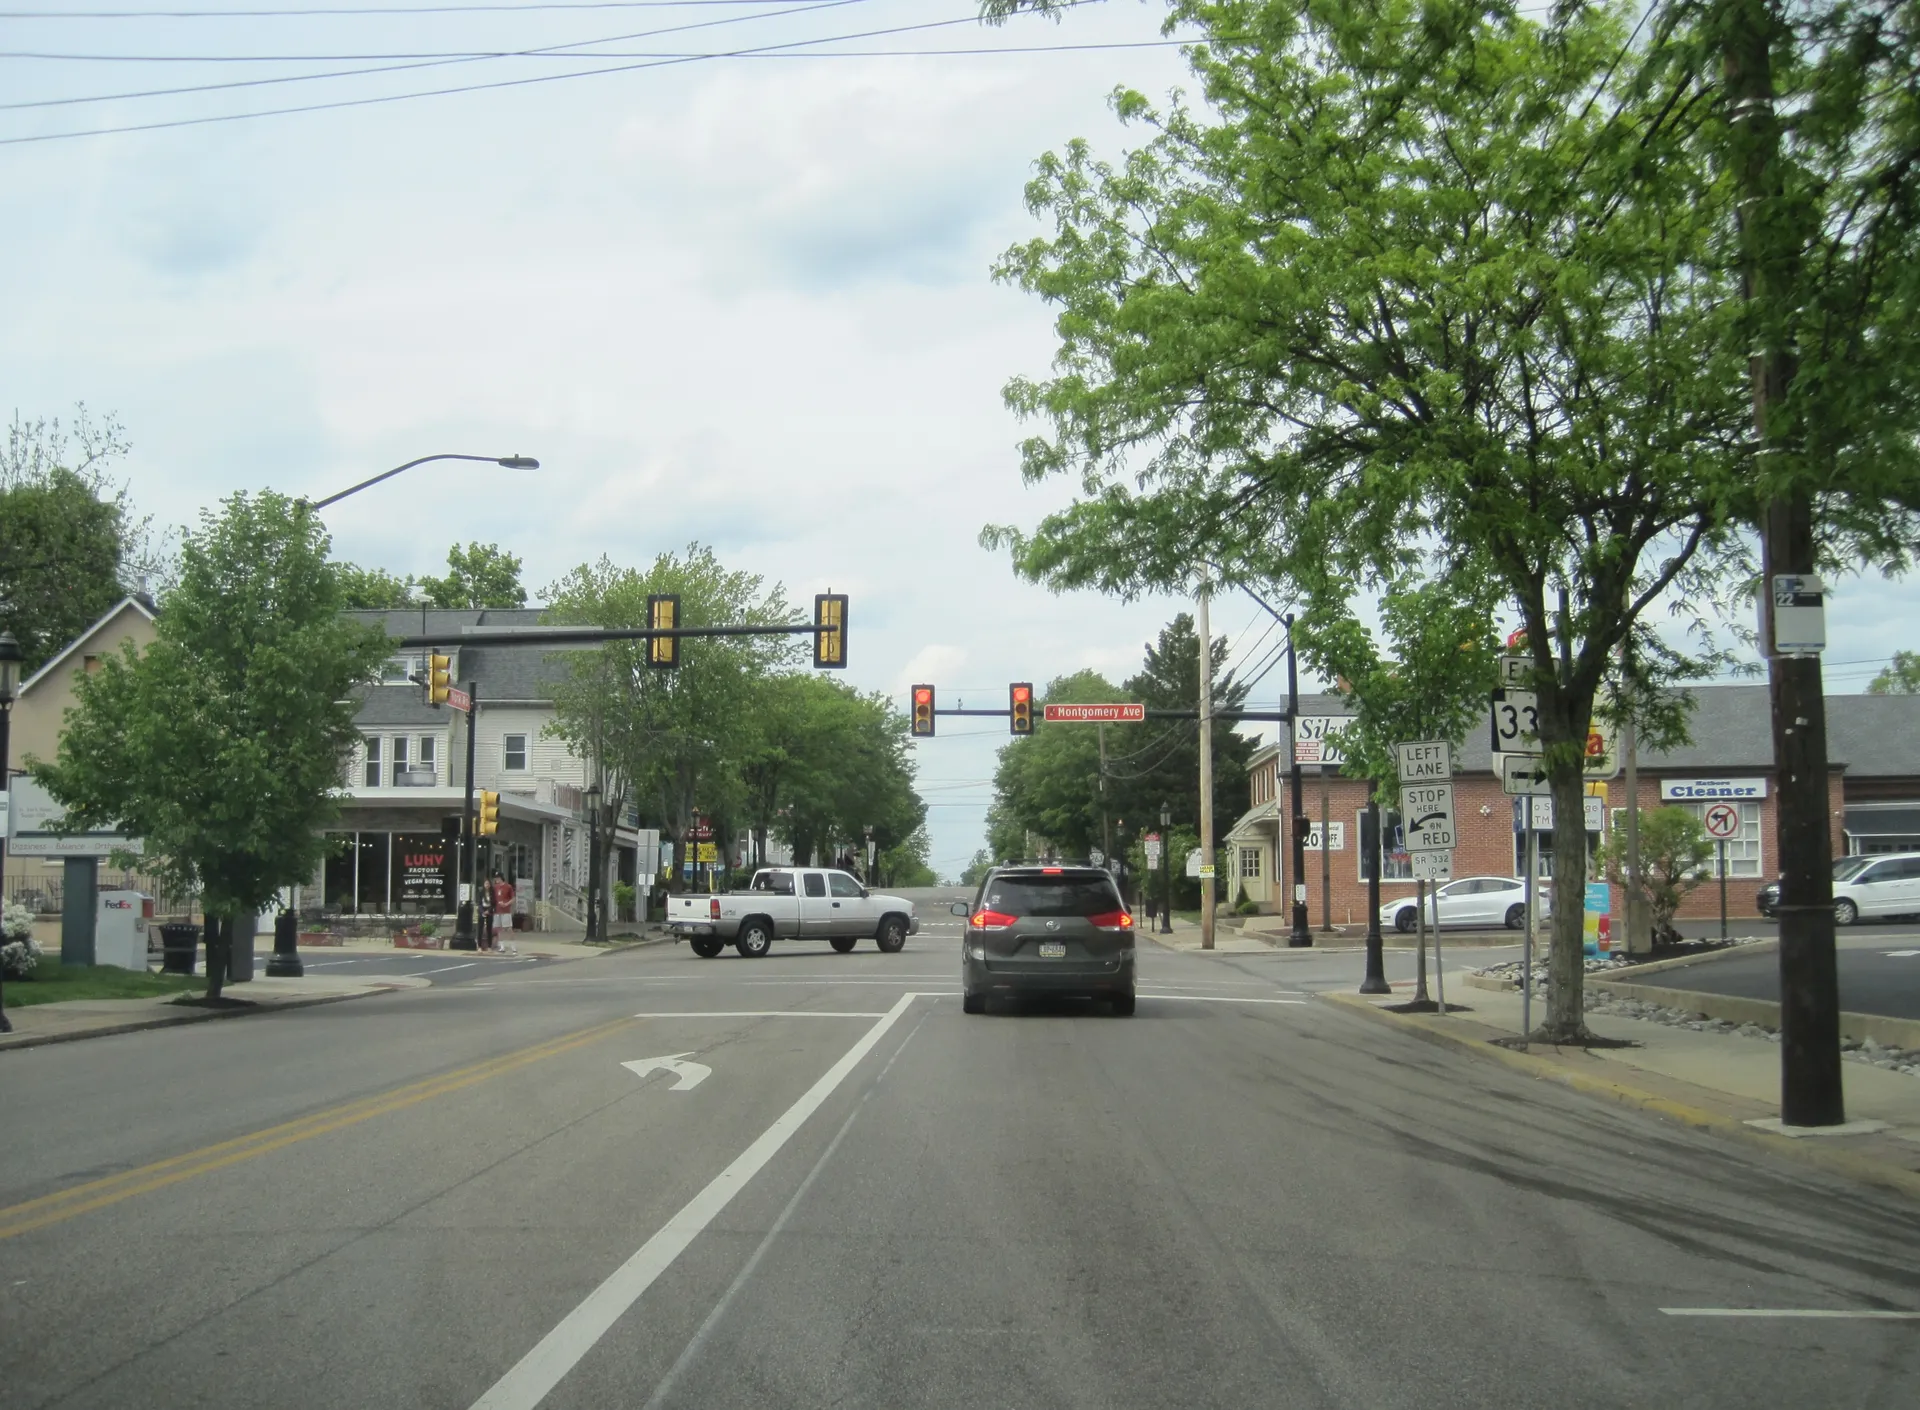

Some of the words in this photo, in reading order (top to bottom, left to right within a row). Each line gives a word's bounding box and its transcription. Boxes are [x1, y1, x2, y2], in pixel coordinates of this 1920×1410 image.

[1777, 593, 1794, 606] 22
[1058, 707, 1119, 718] Montgomery
[1123, 707, 1140, 716] Ave
[1499, 704, 1539, 740] 33
[1406, 746, 1440, 760] LEFT
[1406, 762, 1444, 776] LANE
[1408, 789, 1446, 803] STOP
[1670, 786, 1756, 797] Cleaner
[1416, 804, 1440, 812] HERE
[1430, 822, 1442, 830] ON
[1422, 831, 1451, 845] RED
[56, 842, 85, 850] Balance
[404, 854, 445, 867] LUHV
[1415, 856, 1427, 865] SR
[1432, 855, 1449, 864] 332
[105, 899, 132, 909] FedEx
